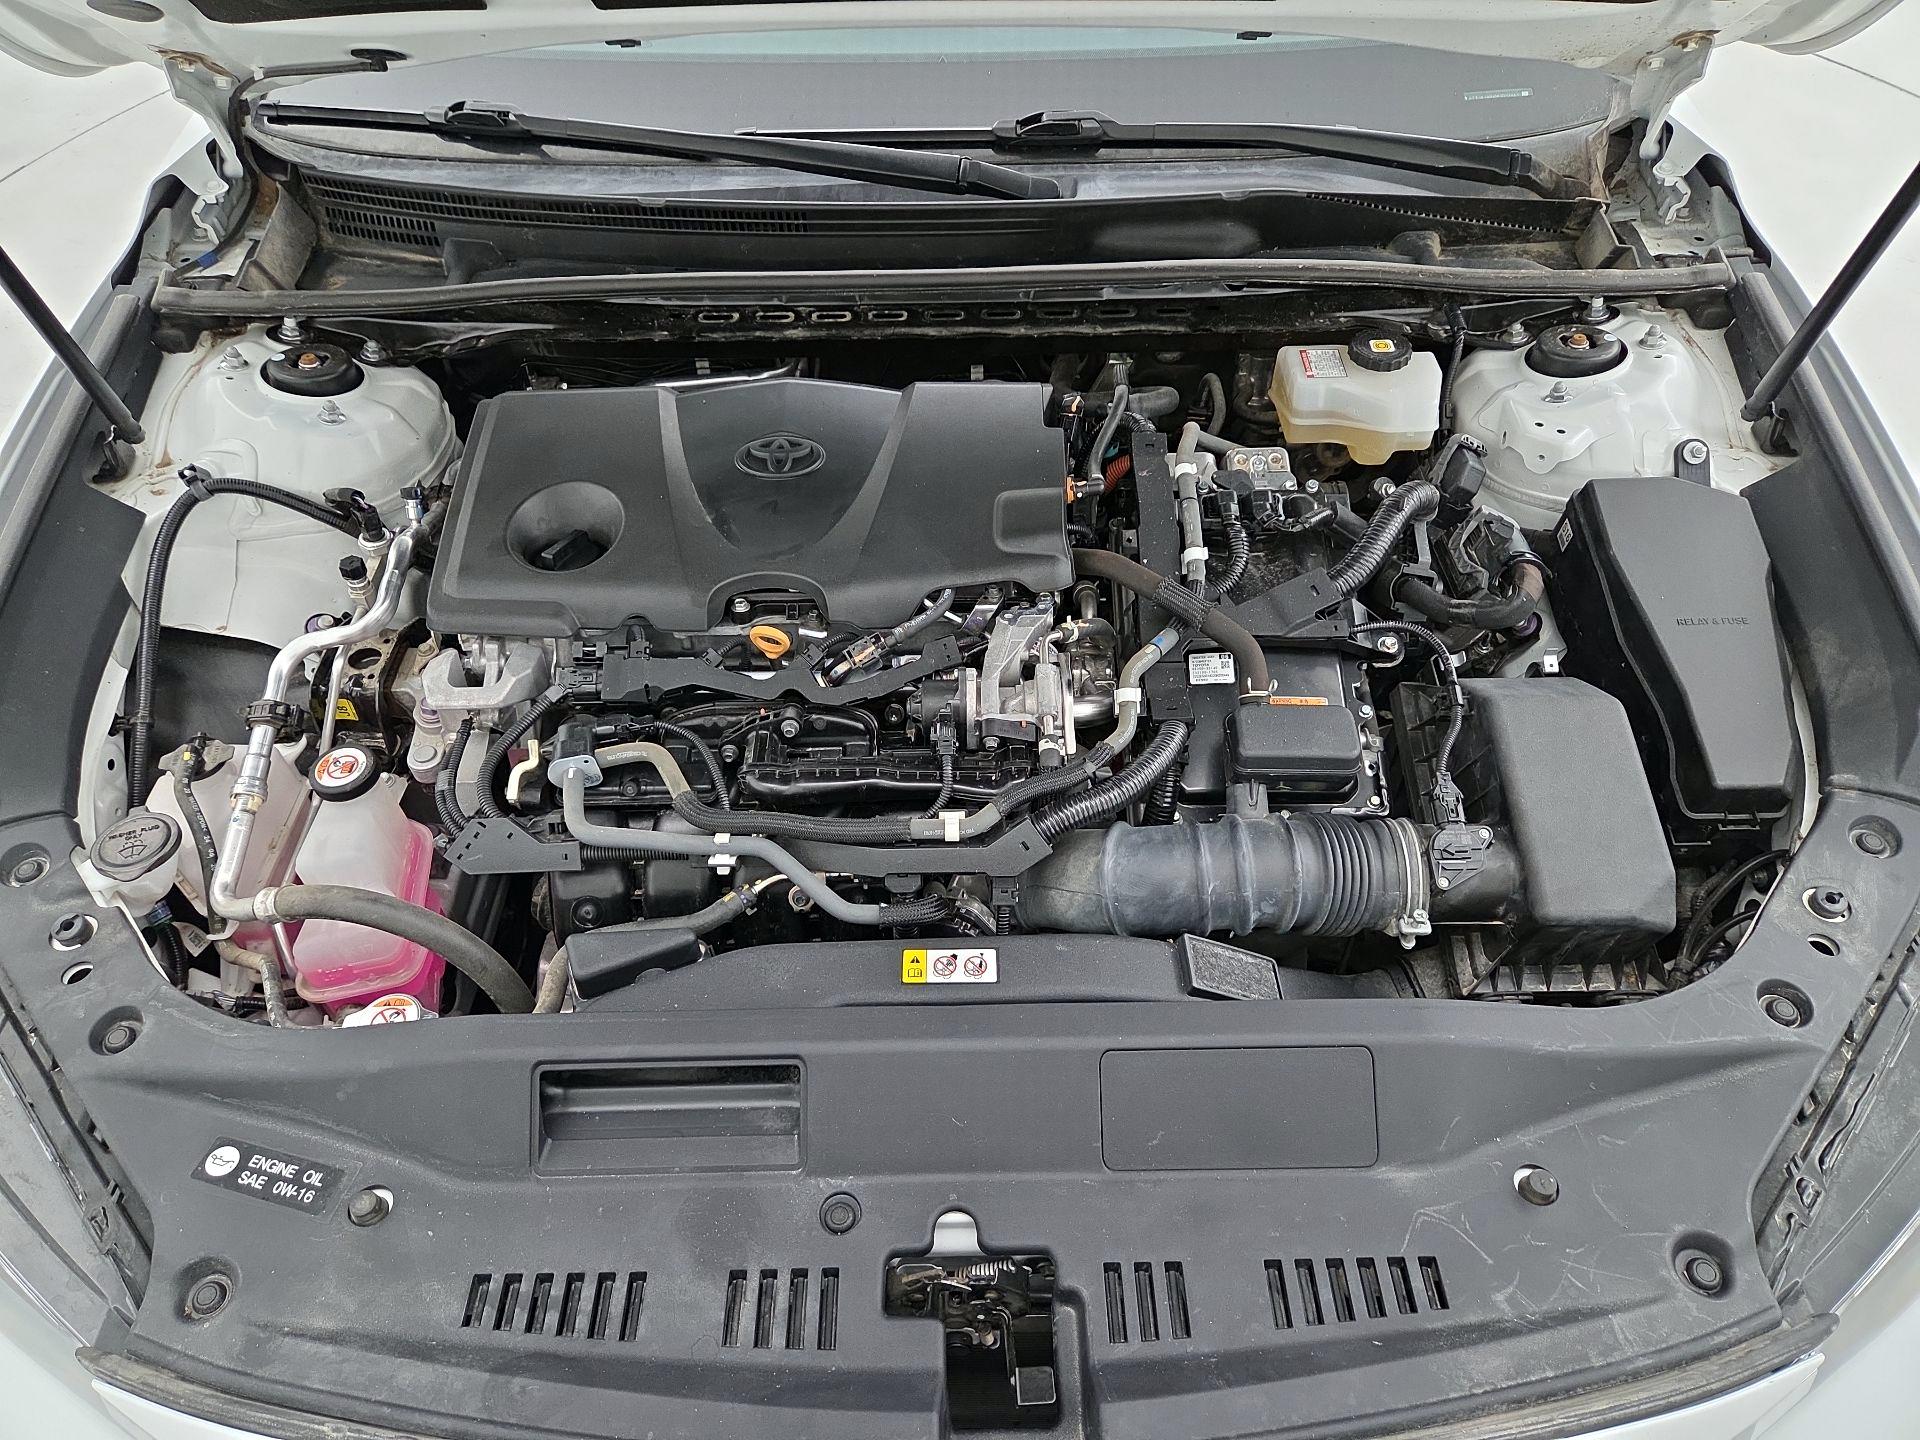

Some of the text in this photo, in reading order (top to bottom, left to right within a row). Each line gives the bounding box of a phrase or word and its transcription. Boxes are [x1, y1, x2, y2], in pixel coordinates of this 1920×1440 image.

[1676, 616, 1749, 626] RELAY & FUSE
[141, 824, 160, 832] FLUID
[248, 1154, 324, 1187] ENGINE OIL
[237, 1170, 316, 1203] SAE 0W-16
